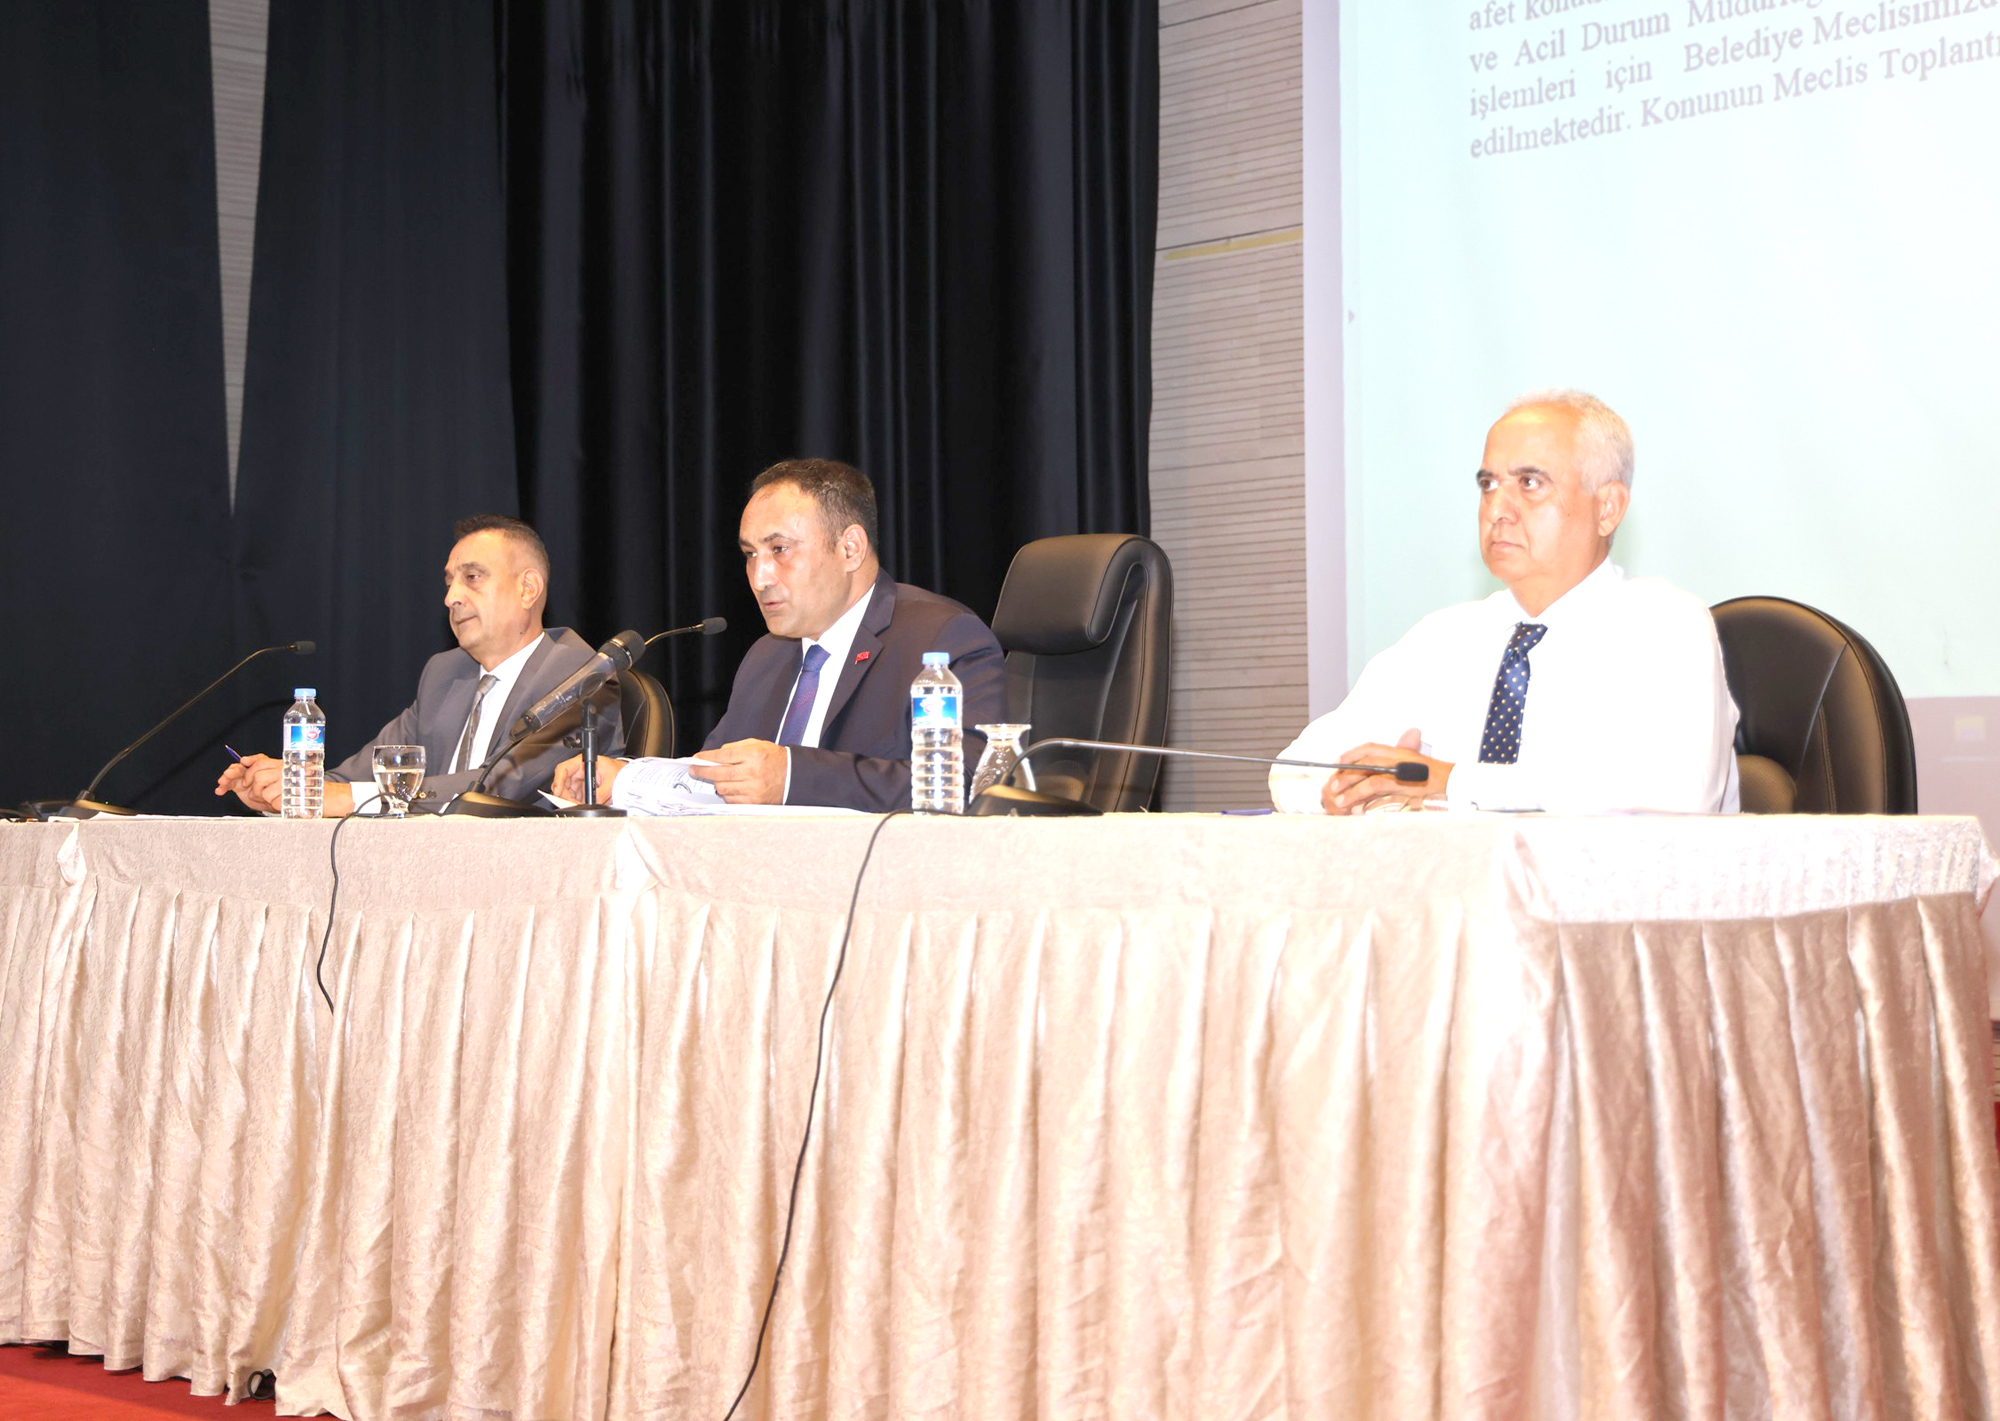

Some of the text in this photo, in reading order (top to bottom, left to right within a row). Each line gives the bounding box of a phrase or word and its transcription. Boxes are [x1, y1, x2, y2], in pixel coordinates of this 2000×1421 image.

[1469, 0, 1516, 31] afet
[1469, 51, 1498, 73] ve
[1514, 28, 1567, 67] Acil
[1581, 11, 1671, 52] Durum
[1469, 69, 1577, 120] işlemleri
[1606, 55, 1653, 94] için
[1684, 26, 1804, 73] Belediye
[1469, 107, 1633, 159] edilmektedir.
[1641, 84, 1764, 127] Konunun
[1773, 55, 1868, 101] Meclis
